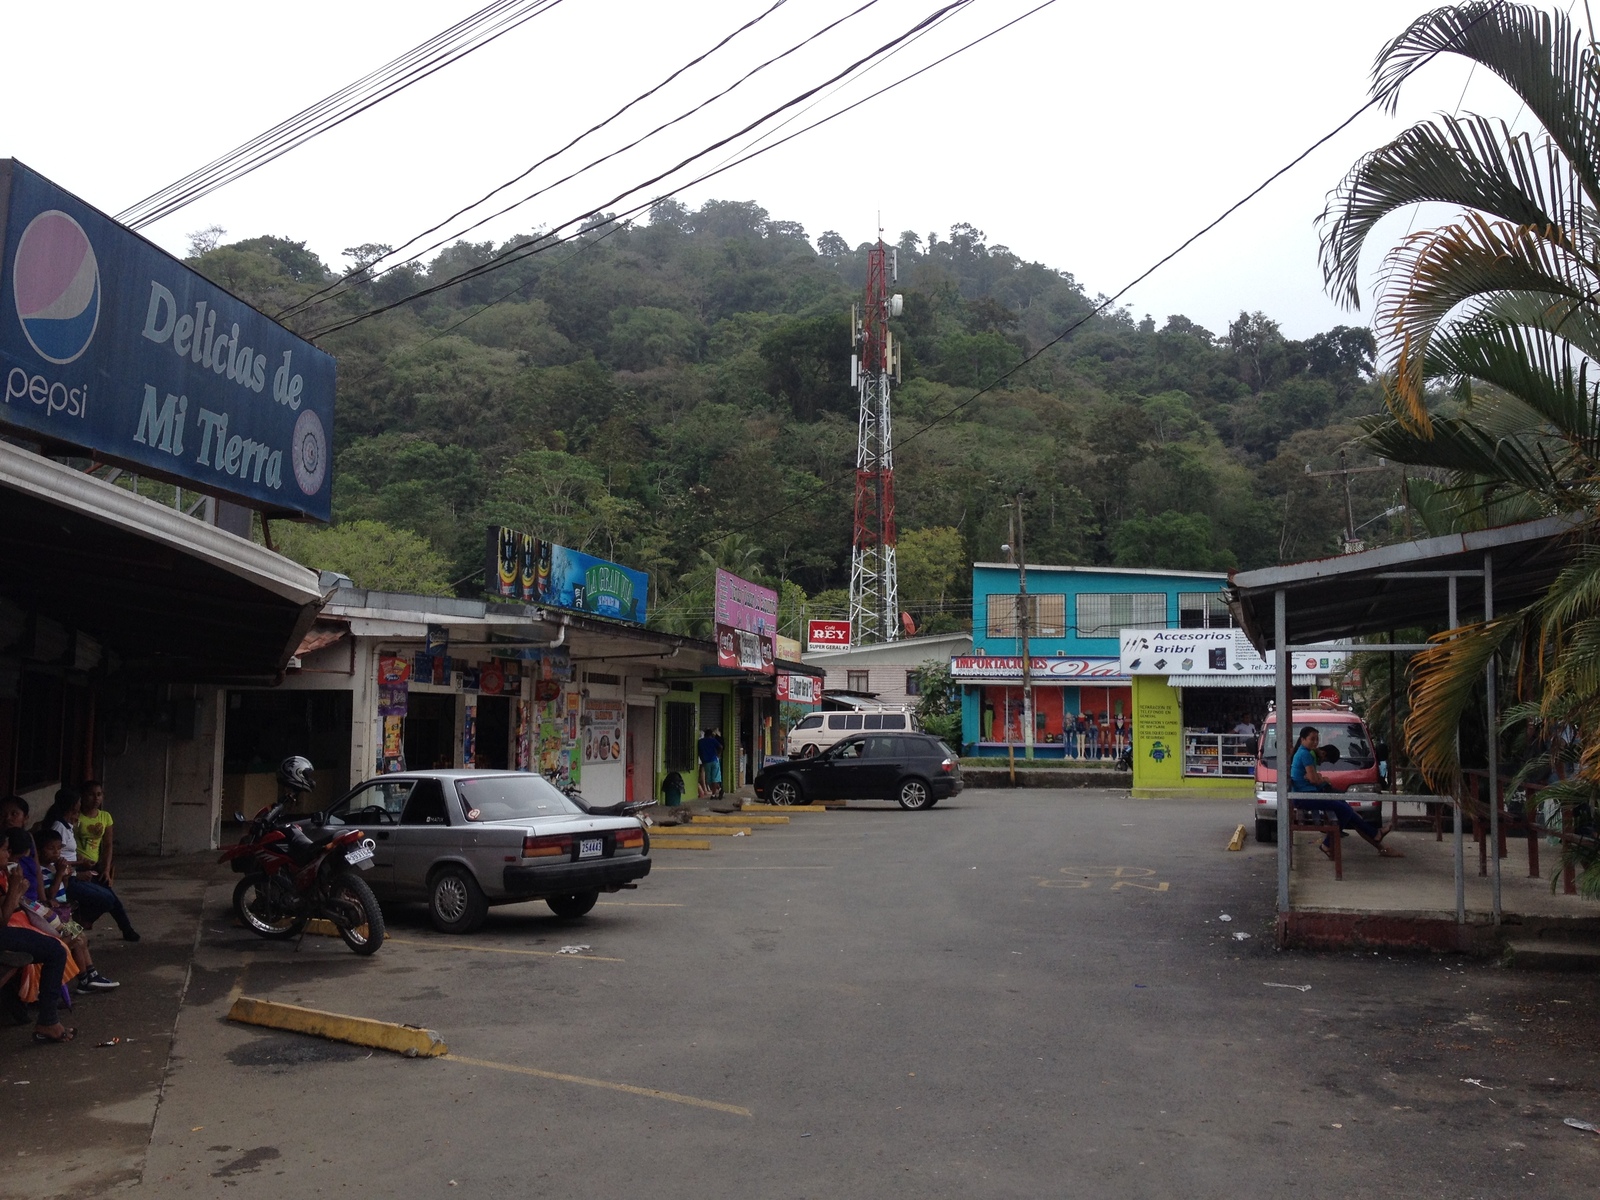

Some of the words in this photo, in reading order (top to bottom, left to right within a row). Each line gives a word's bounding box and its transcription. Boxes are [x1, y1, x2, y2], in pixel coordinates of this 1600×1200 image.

[141, 280, 267, 393] Delicias
[273, 350, 304, 411] de
[6, 367, 88, 419] pepsi
[133, 383, 188, 457] Mi
[196, 407, 283, 490] Tierra
[813, 629, 846, 639] REY
[1153, 631, 1232, 640] Accesorios
[1154, 644, 1197, 653] Bribrí
